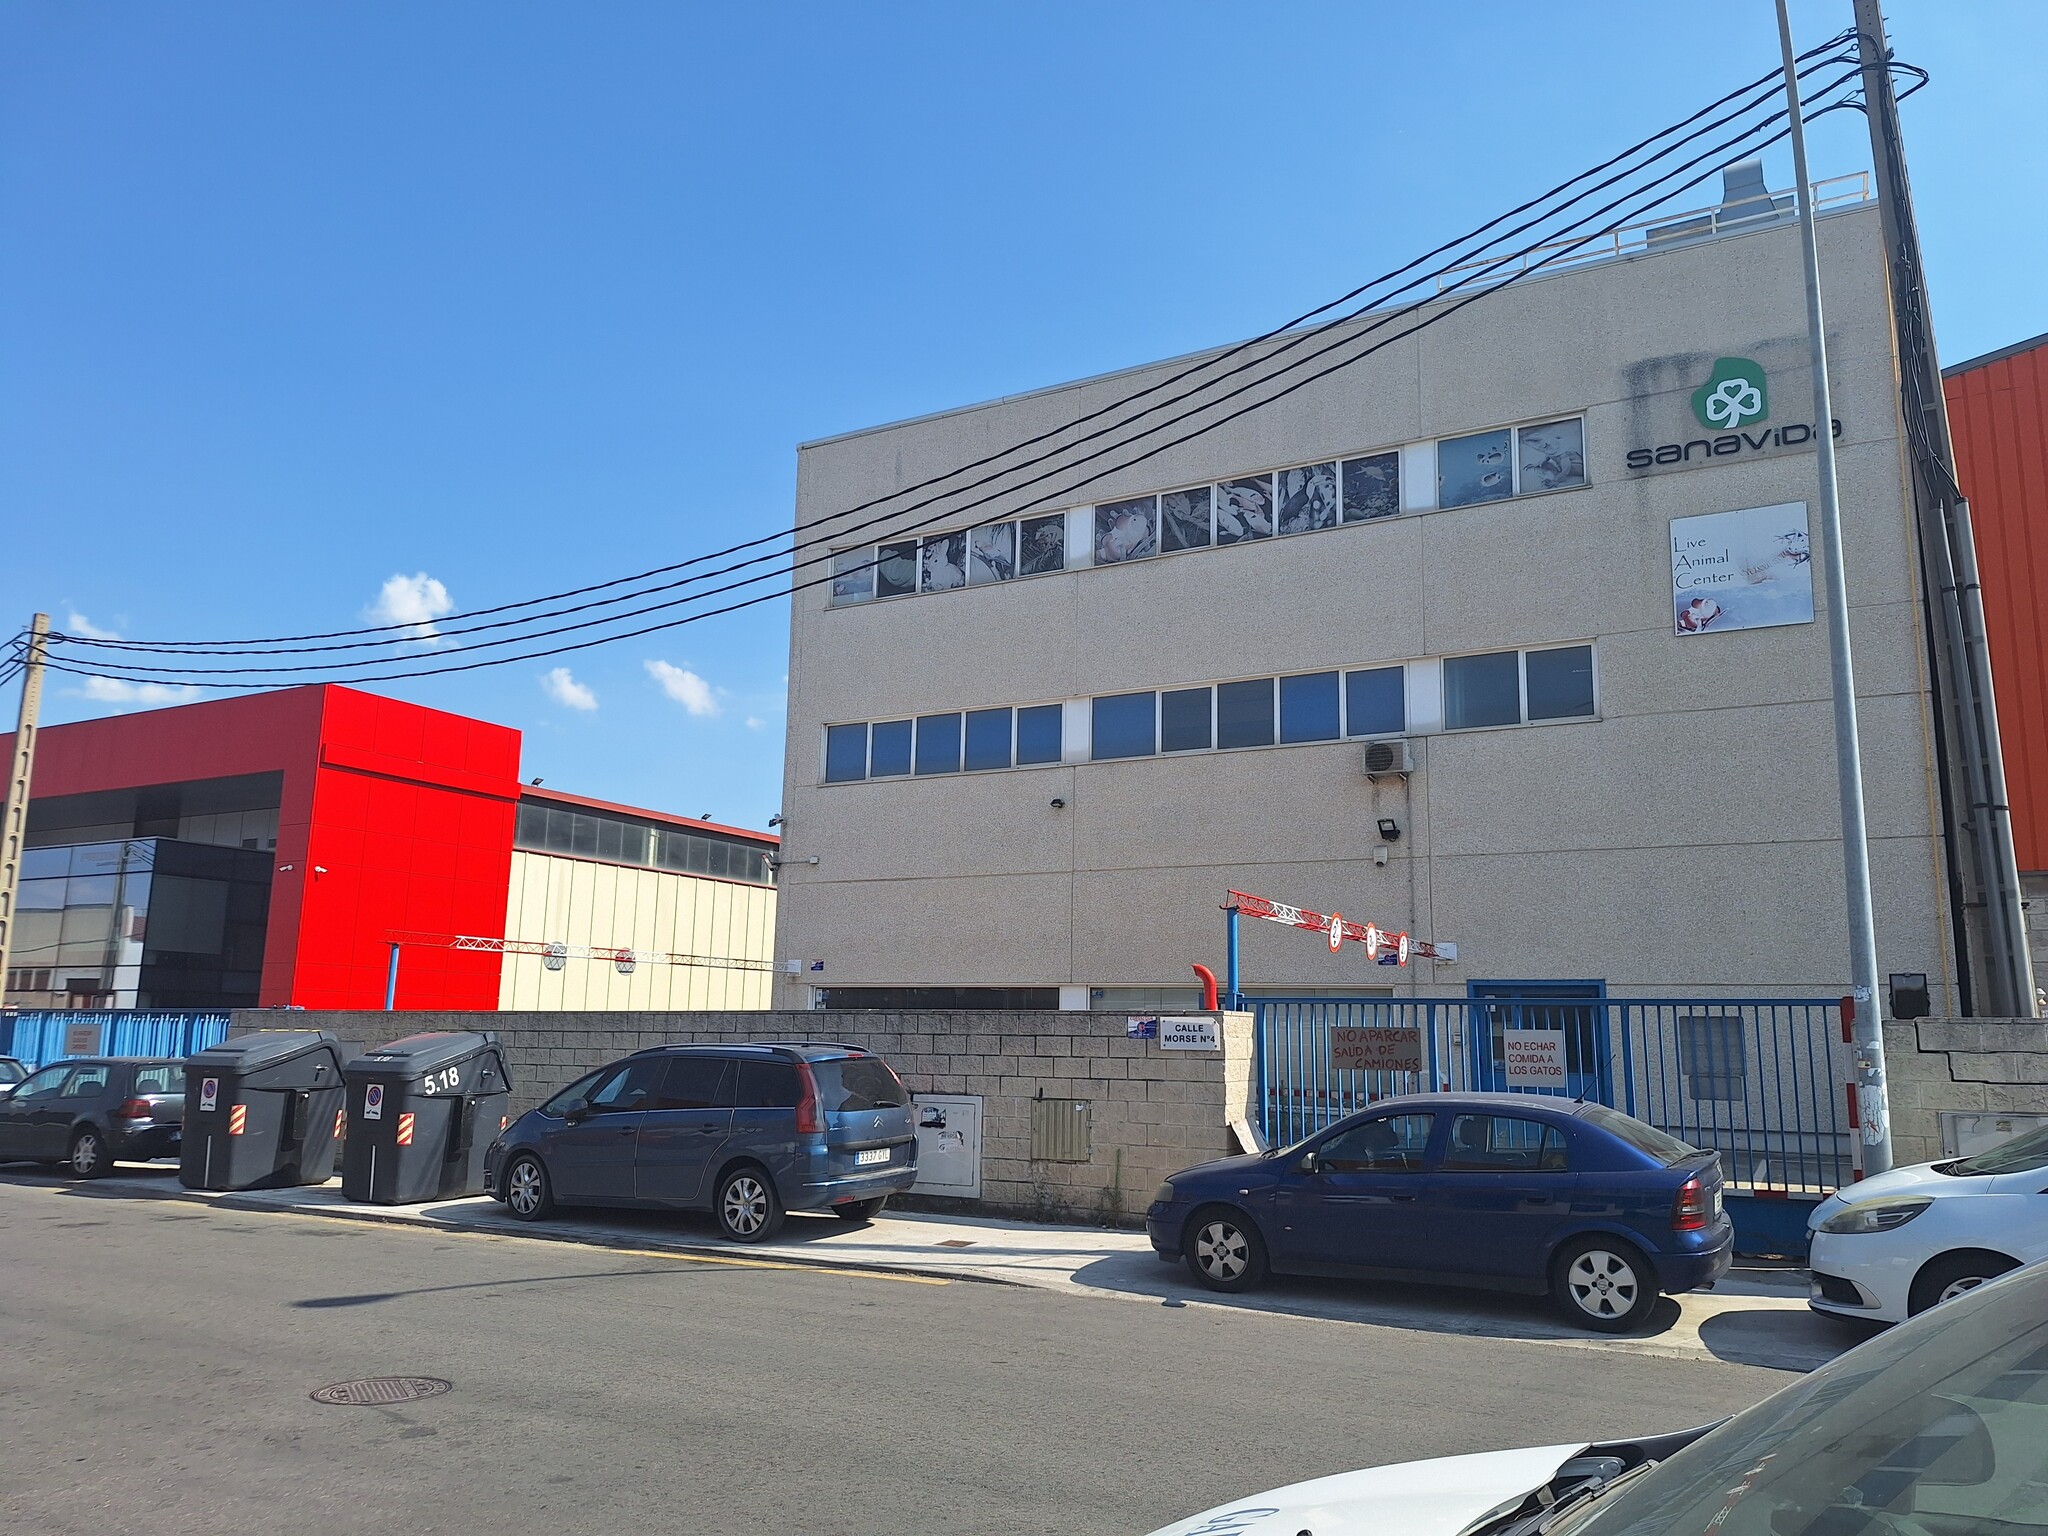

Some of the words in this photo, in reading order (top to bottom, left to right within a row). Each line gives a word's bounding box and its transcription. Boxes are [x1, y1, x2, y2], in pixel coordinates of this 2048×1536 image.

[1674, 537, 1707, 553] Live
[1674, 549, 1729, 571] Animal
[1675, 572, 1735, 590] Center
[1174, 1024, 1204, 1033] CALLE
[1164, 1034, 1197, 1043] MORSE
[1336, 1029, 1357, 1043] NO
[1360, 1029, 1418, 1043] APARCAR
[1378, 1044, 1396, 1056] DE
[1508, 1042, 1522, 1051] NO
[1524, 1042, 1556, 1051] ECHAR
[1355, 1057, 1419, 1070] CAMIONES
[1508, 1054, 1545, 1063] COMIDA
[1547, 1055, 1554, 1063] A
[1509, 1066, 1527, 1075] LOS
[1530, 1066, 1562, 1075] GATOS
[424, 1066, 460, 1095] 5.18
[860, 1151, 877, 1162] 3337
